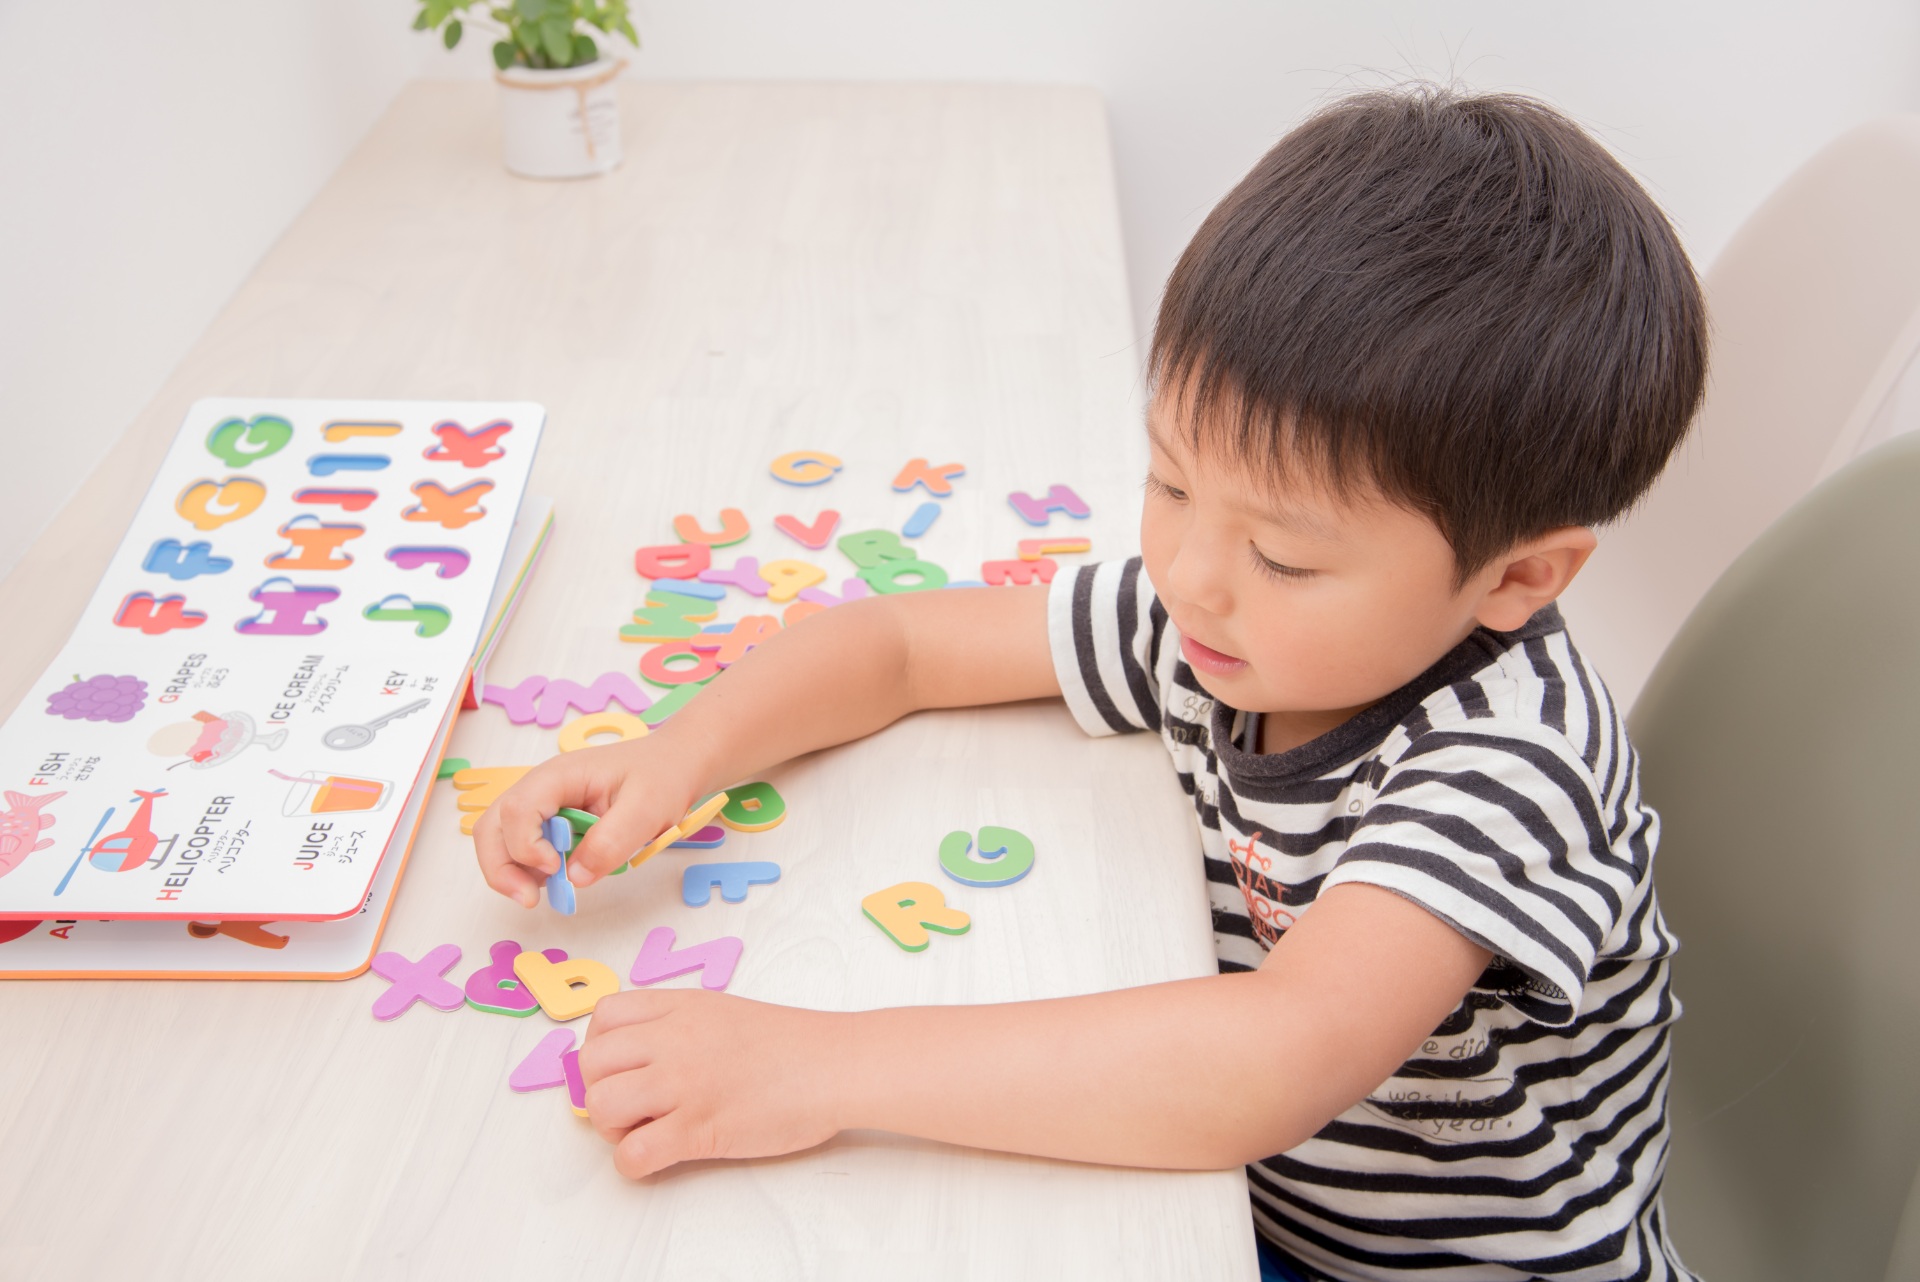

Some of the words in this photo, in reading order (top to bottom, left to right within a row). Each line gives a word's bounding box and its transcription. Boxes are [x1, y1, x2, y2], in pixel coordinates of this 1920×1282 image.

[892, 458, 966, 498] K
[158, 653, 207, 704] GRAPES
[265, 701, 297, 725] ICE
[282, 654, 325, 699] CREAM
[311, 664, 350, 714] アイスクリーム
[379, 670, 409, 695] KEY
[28, 752, 71, 786] FISH
[75, 756, 102, 782] さかな
[155, 795, 236, 901] HELICOPTER
[217, 819, 252, 875] ヘリコプター
[292, 822, 335, 871] JUICE
[337, 829, 367, 865] ジュース
[938, 825, 1036, 888] G
[861, 881, 971, 953] R
[371, 944, 467, 1022] X
